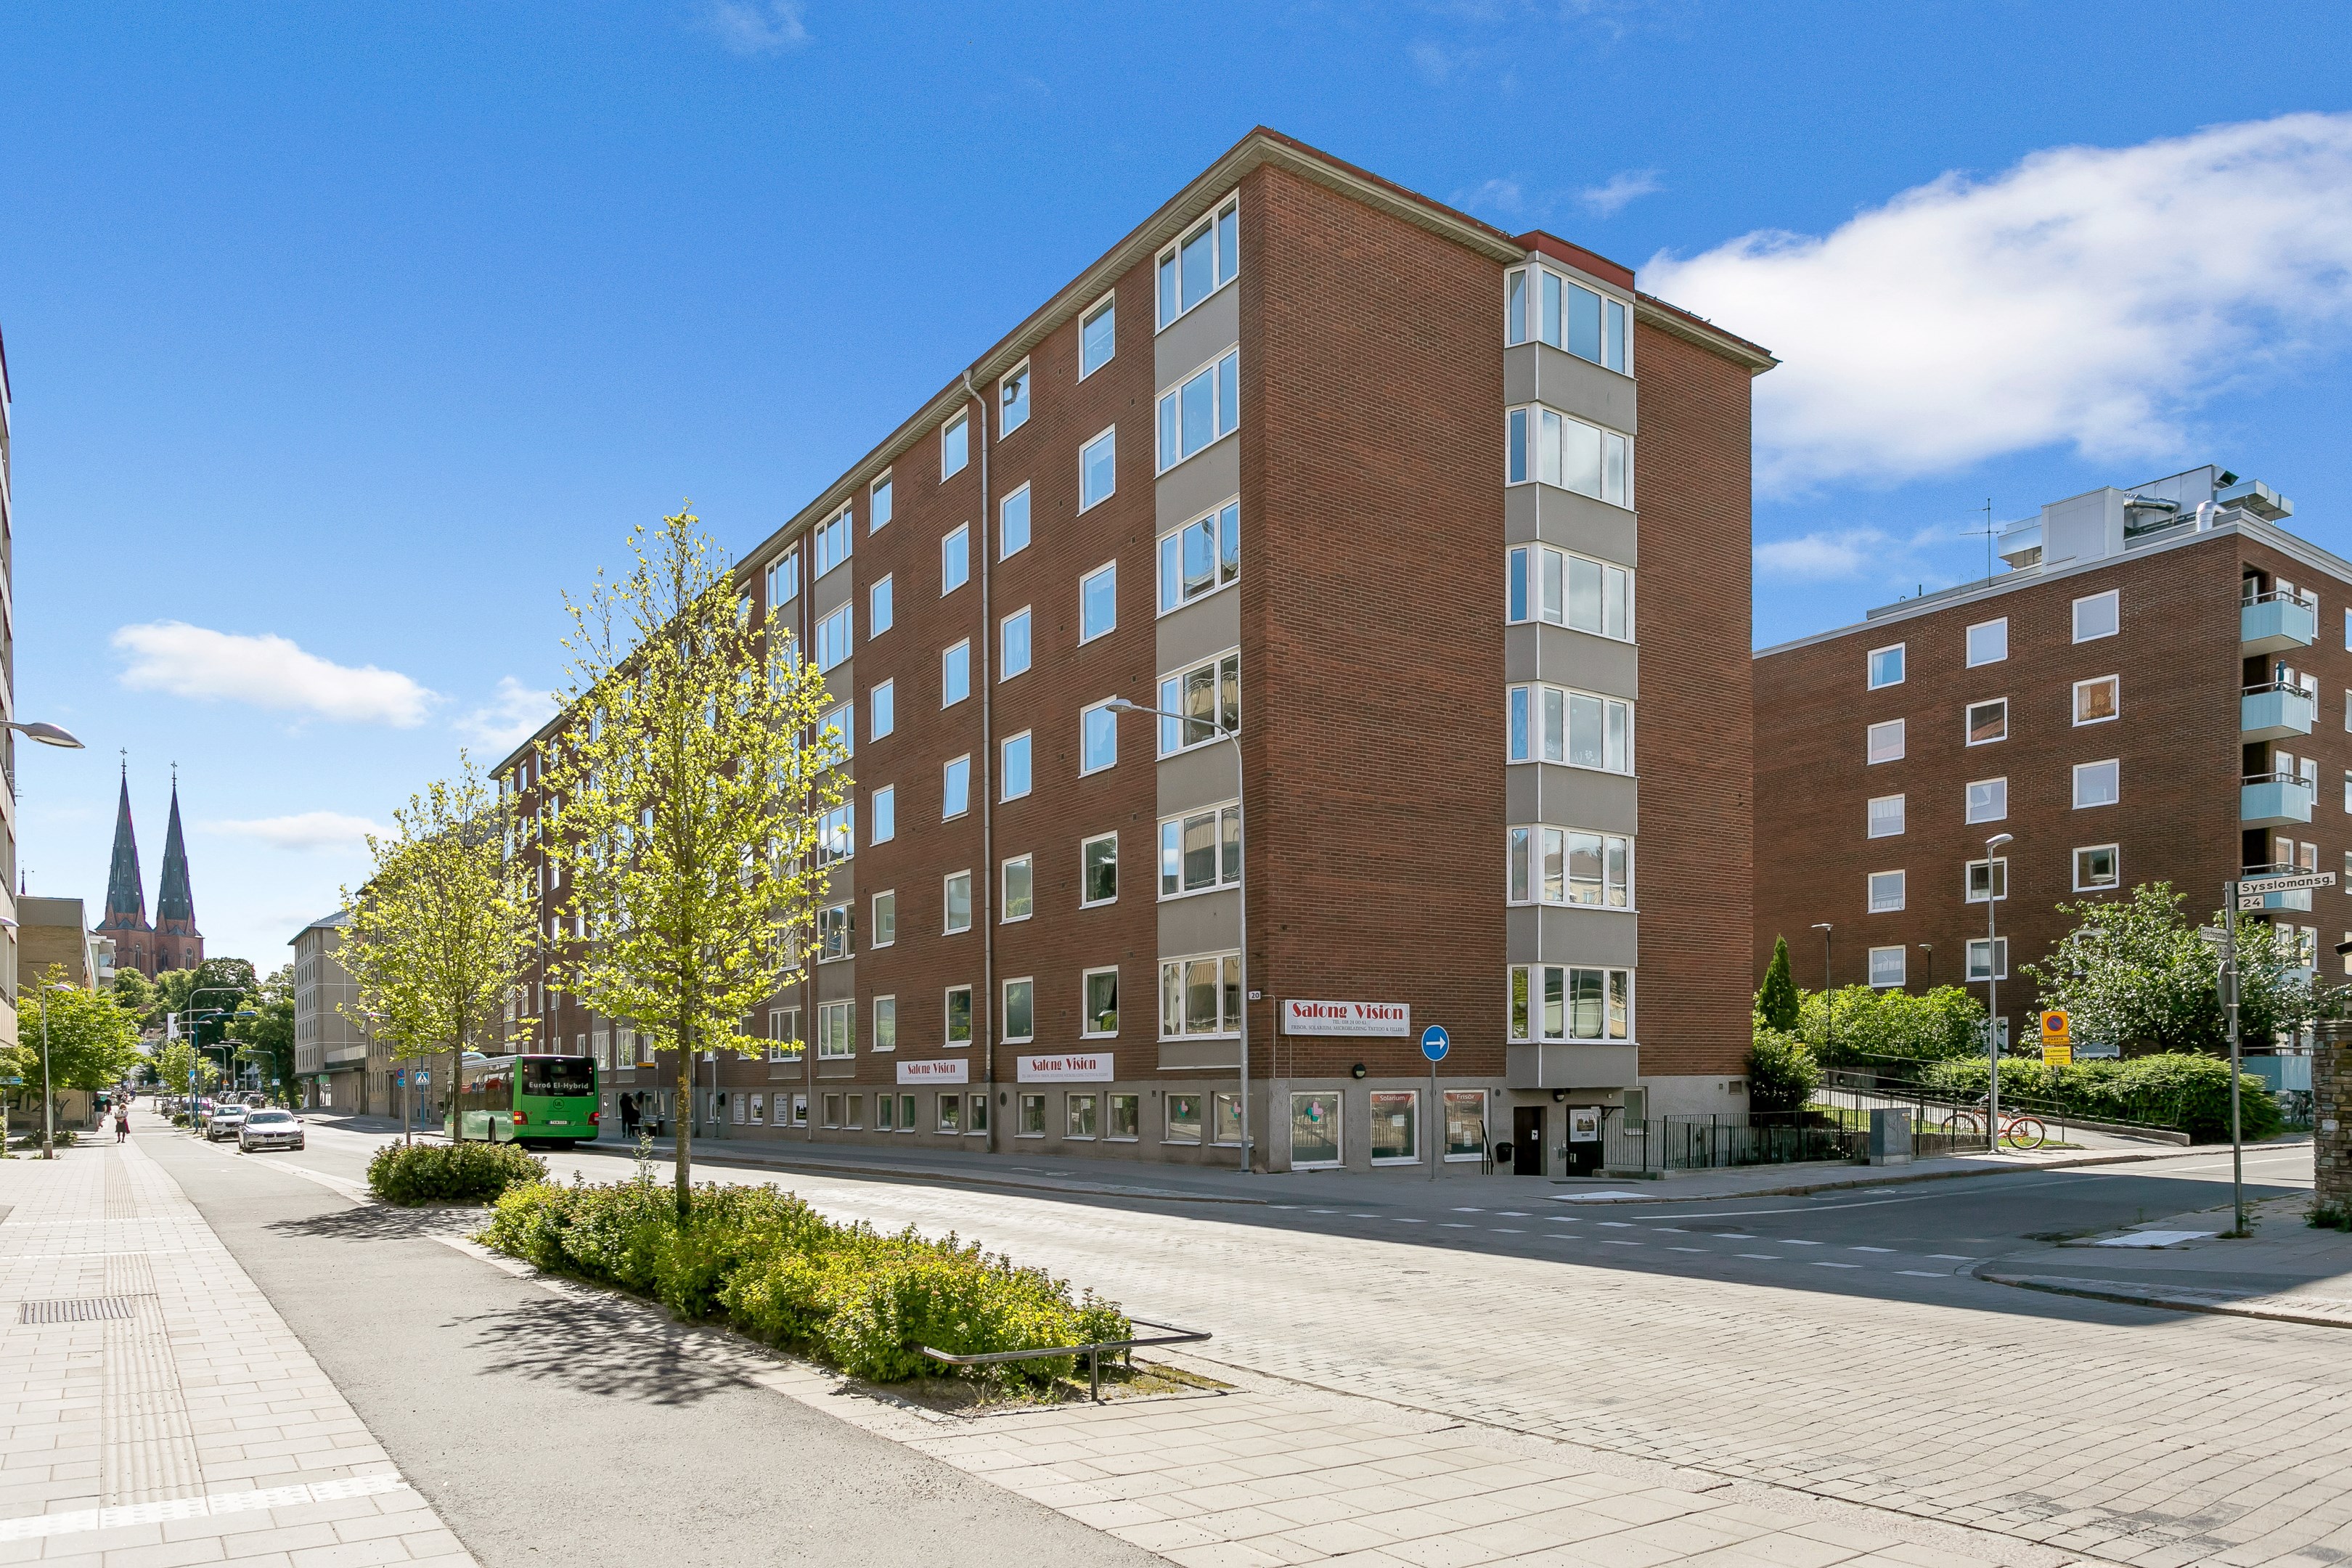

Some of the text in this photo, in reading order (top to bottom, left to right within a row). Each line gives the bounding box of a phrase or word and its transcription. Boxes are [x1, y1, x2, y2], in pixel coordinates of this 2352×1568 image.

[2242, 875, 2333, 893] Sysslomansg.
[2242, 897, 2261, 907] 24
[1292, 1003, 1403, 1020] Salong Vision
[907, 1062, 956, 1074] Salong Vision
[1032, 1057, 1096, 1071] Salong Vision
